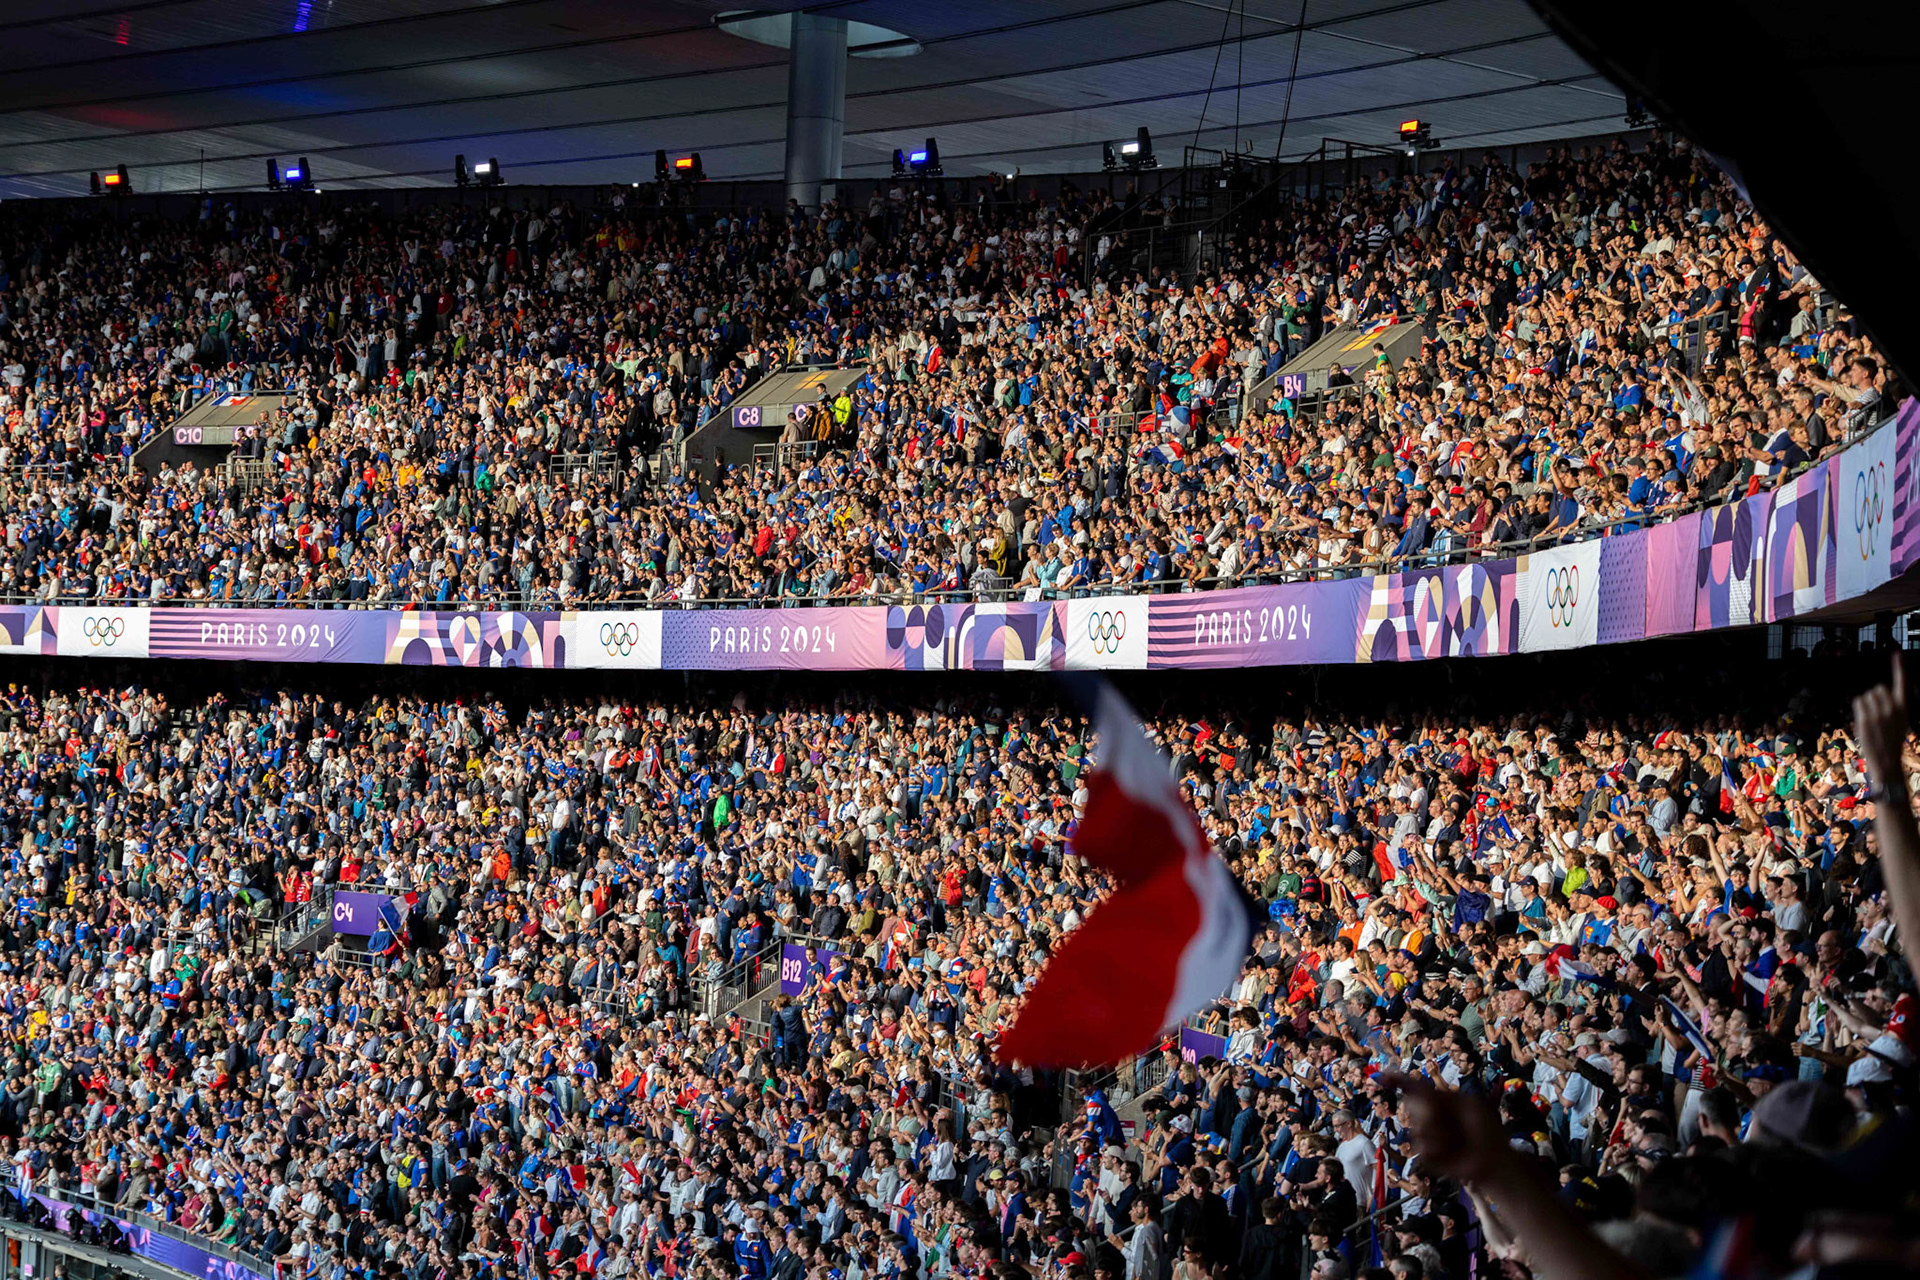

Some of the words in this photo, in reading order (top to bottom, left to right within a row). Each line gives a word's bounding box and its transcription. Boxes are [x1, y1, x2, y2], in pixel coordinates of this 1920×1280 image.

[1284, 375, 1301, 398] B4
[738, 407, 759, 426] C8
[175, 427, 202, 444] C10
[1258, 604, 1311, 642] 2024
[277, 623, 335, 648] 2024
[779, 625, 836, 653] 2024
[334, 901, 353, 922] C4
[782, 957, 802, 983] B12
